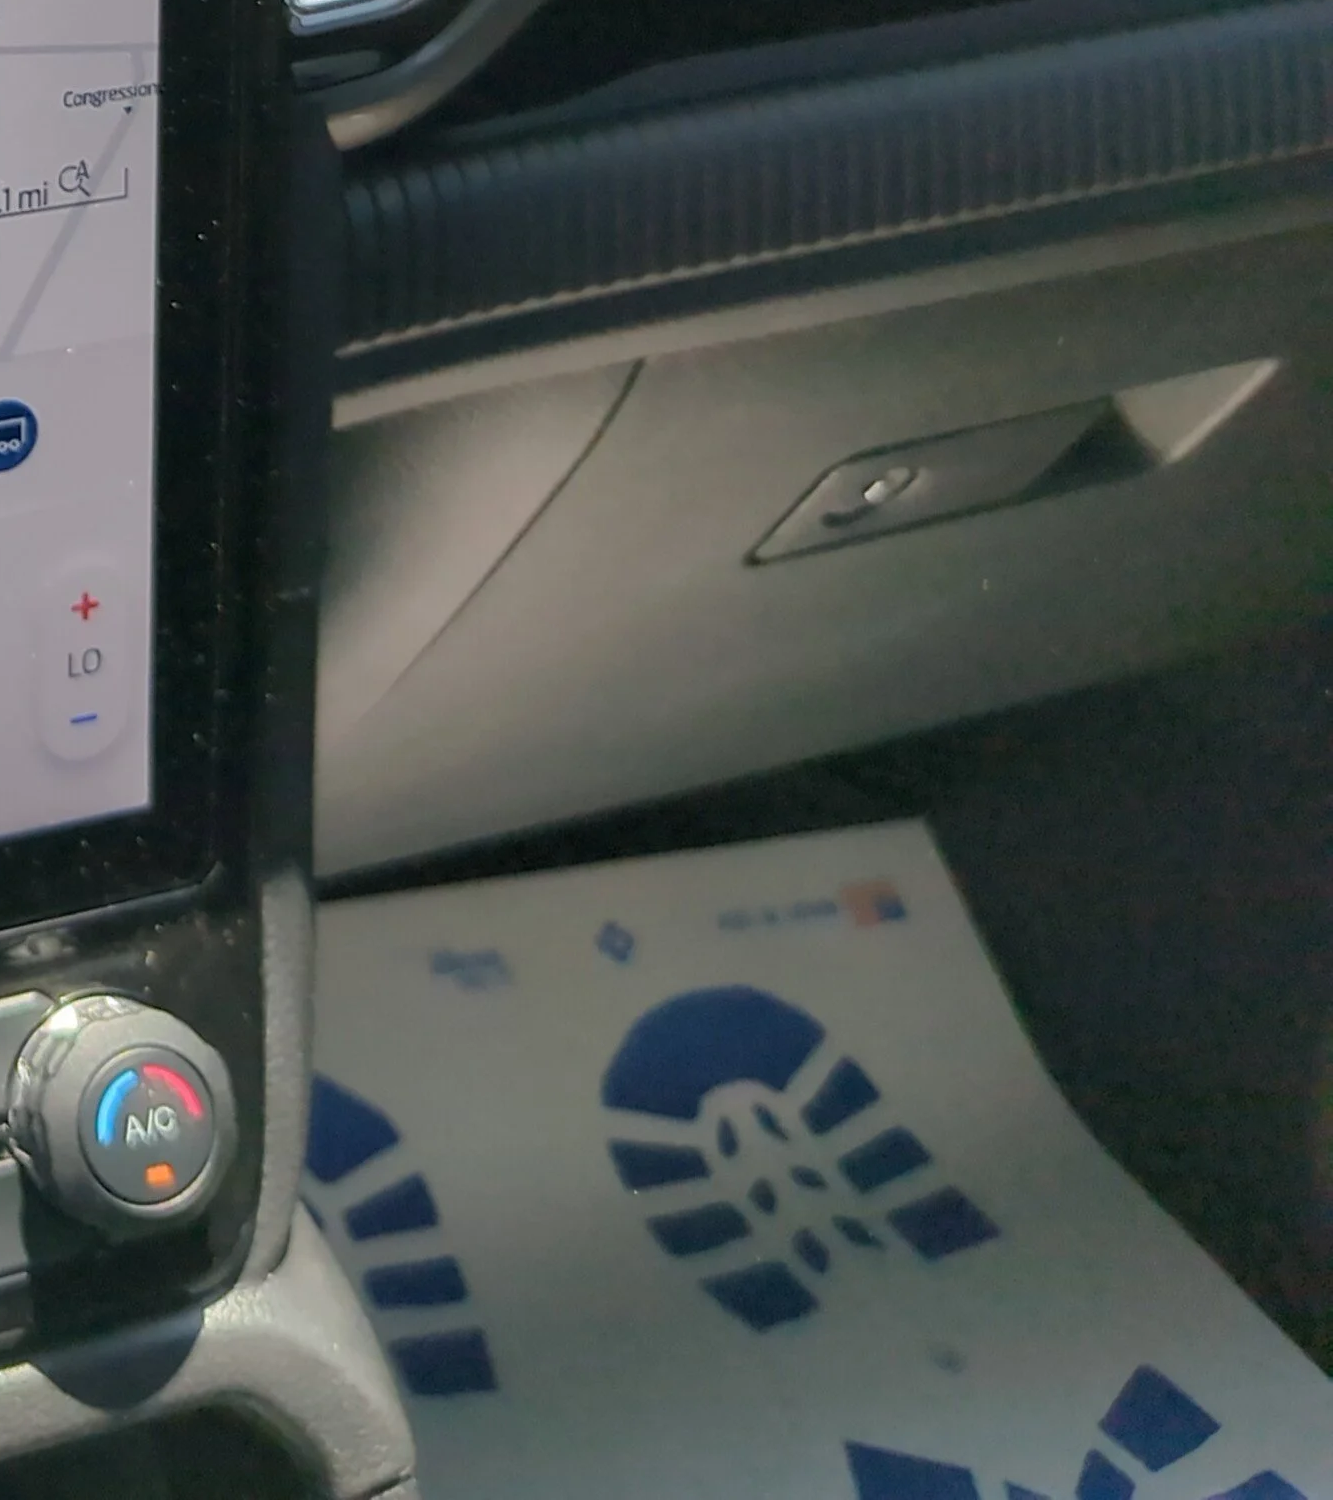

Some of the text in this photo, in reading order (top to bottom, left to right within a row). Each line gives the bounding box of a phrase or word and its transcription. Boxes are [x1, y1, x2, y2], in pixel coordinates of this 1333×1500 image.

[18, 183, 49, 209] mi
[67, 648, 101, 678] LO
[125, 1104, 177, 1141] A/C
